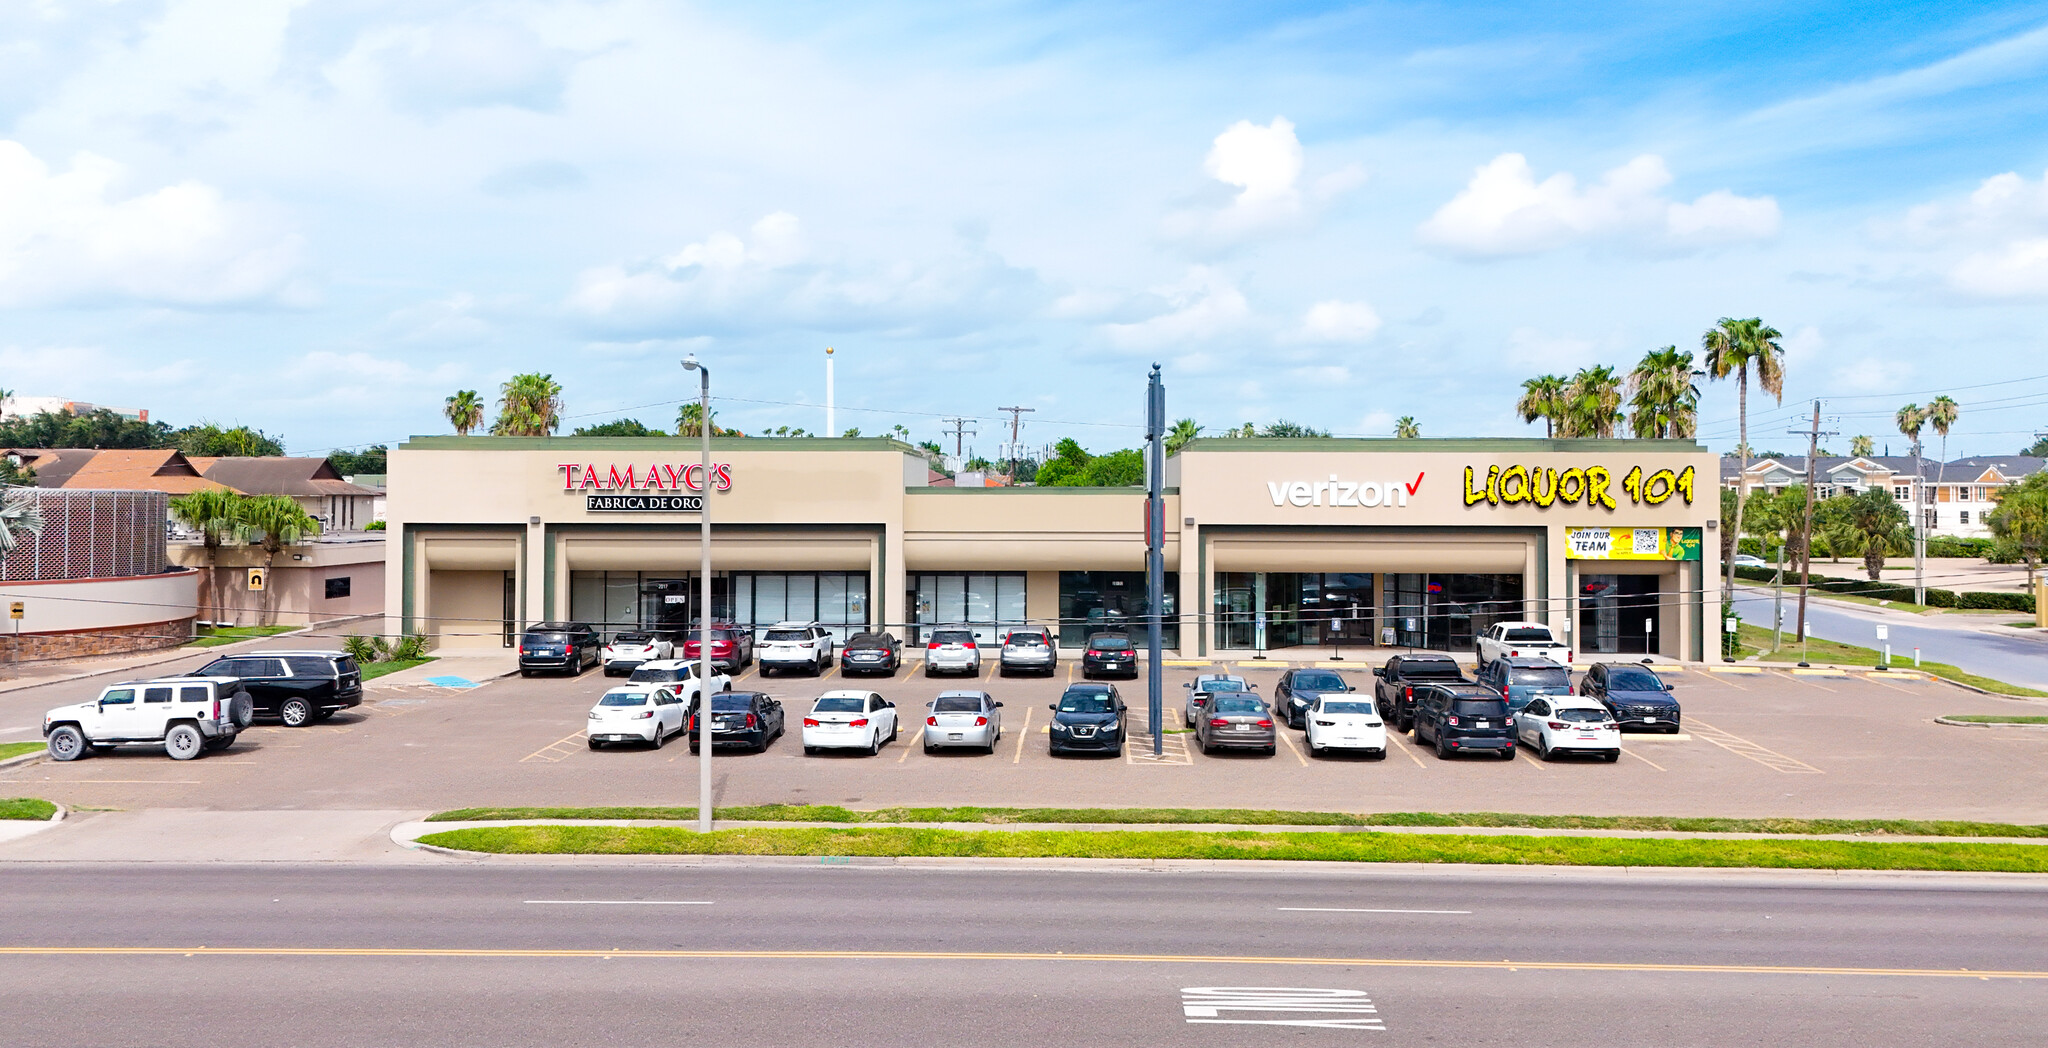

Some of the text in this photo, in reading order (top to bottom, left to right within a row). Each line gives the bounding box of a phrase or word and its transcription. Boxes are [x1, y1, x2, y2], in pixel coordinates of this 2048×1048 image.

[557, 463, 732, 490] TAMAYO'S
[1622, 465, 1696, 506] 101
[588, 498, 702, 509] FABRICA DE ORO
[1267, 474, 1407, 507] verizon
[1571, 531, 1610, 540] JOIN OUR
[1575, 541, 1607, 551] TEAM
[1180, 986, 1386, 1031] ONLY
